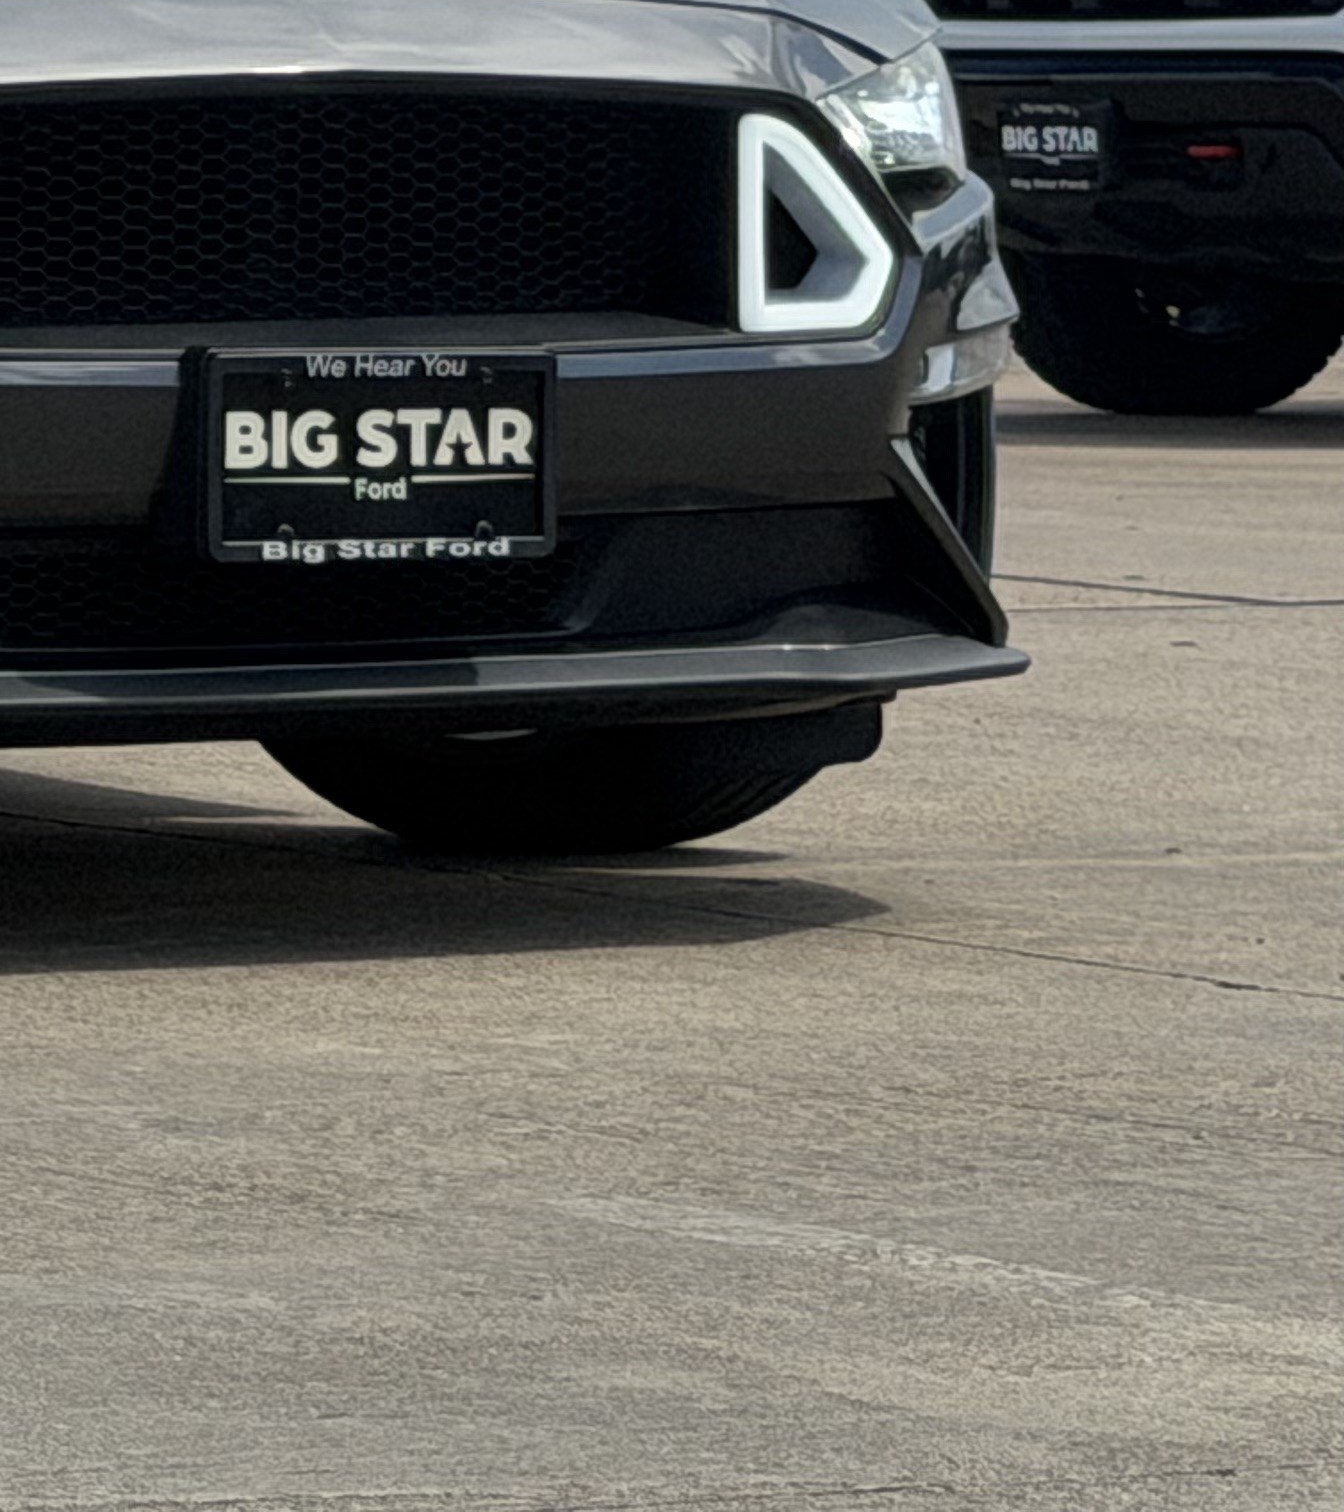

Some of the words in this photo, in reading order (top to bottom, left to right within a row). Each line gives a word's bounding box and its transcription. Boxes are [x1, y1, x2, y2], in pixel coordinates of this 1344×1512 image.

[1001, 124, 1039, 152] BIG
[1042, 125, 1099, 153] STAR
[305, 354, 348, 379] We
[354, 354, 415, 379] Hear
[418, 353, 468, 377] You
[224, 410, 339, 470] BIG
[355, 408, 534, 468] STAR
[355, 477, 407, 501] Ford
[262, 540, 326, 564] Big
[337, 539, 414, 561] Star
[425, 537, 511, 559] Ford
